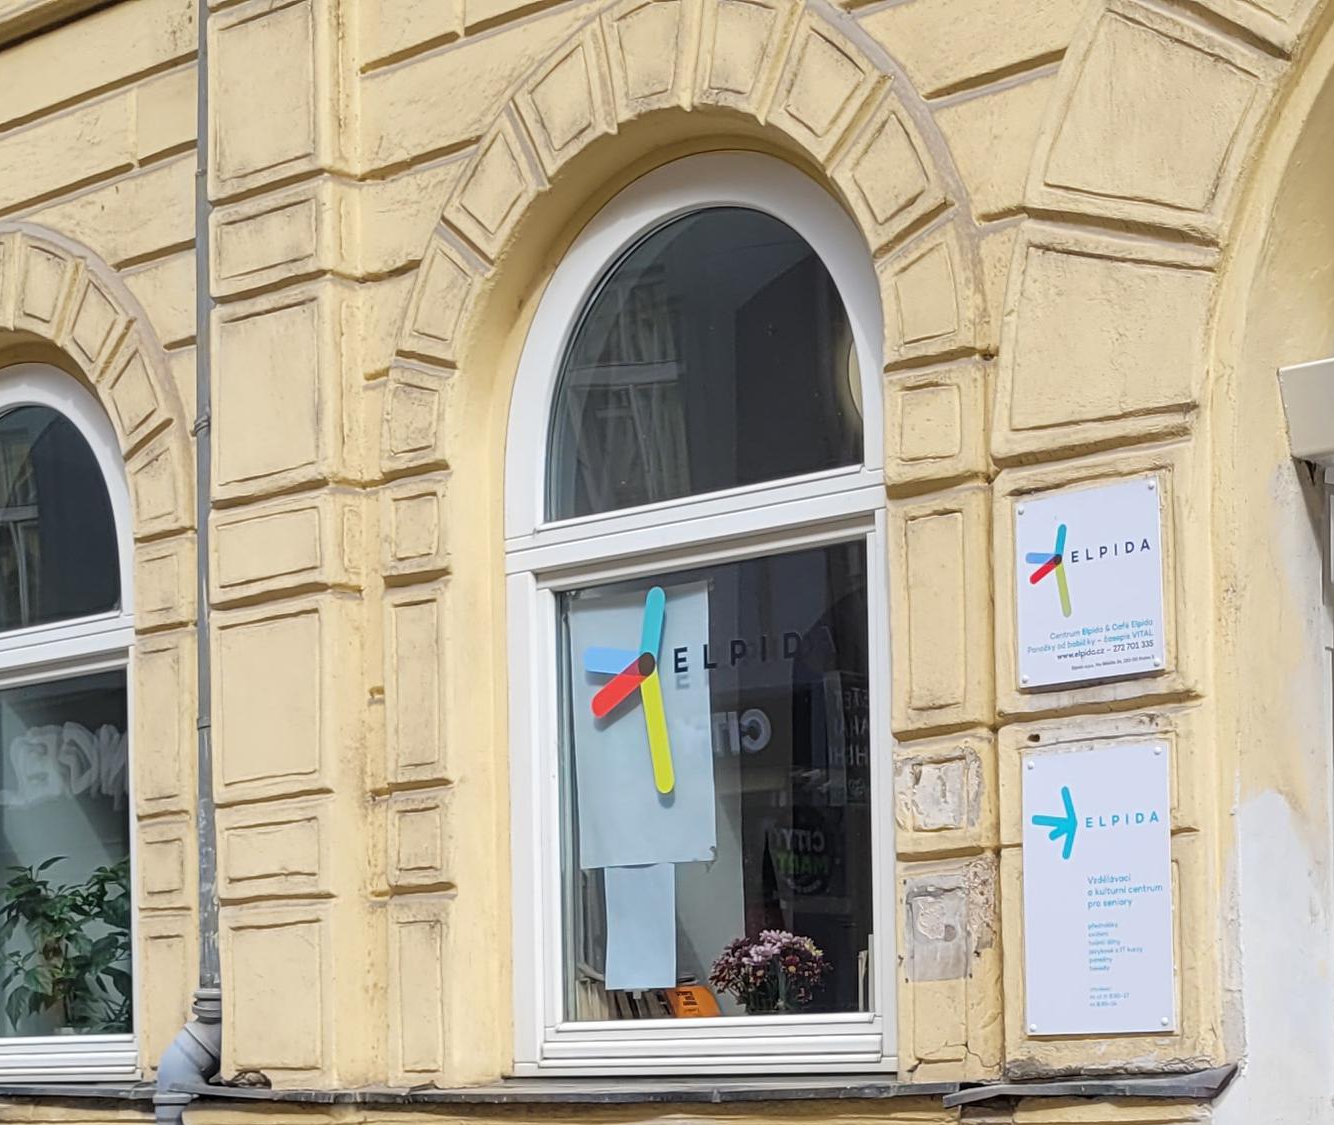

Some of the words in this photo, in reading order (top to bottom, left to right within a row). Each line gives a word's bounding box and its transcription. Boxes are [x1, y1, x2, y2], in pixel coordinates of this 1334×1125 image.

[1070, 538, 1151, 563] ELPIDA
[1049, 629, 1081, 640] Centrum
[1082, 626, 1104, 637] Elpida
[1131, 618, 1153, 629] Elpida
[1132, 629, 1154, 639] VITAL
[1056, 648, 1105, 660] www.elpida.cz
[1113, 644, 1126, 653] 272
[1127, 641, 1139, 651] 701
[1085, 811, 1160, 829] ELPIDA
[1087, 873, 1131, 884] Vzdělávací
[1095, 885, 1127, 896] kulturní
[1128, 884, 1163, 894] centrum
[1087, 900, 1101, 910] pro
[1103, 899, 1132, 908] seniory
